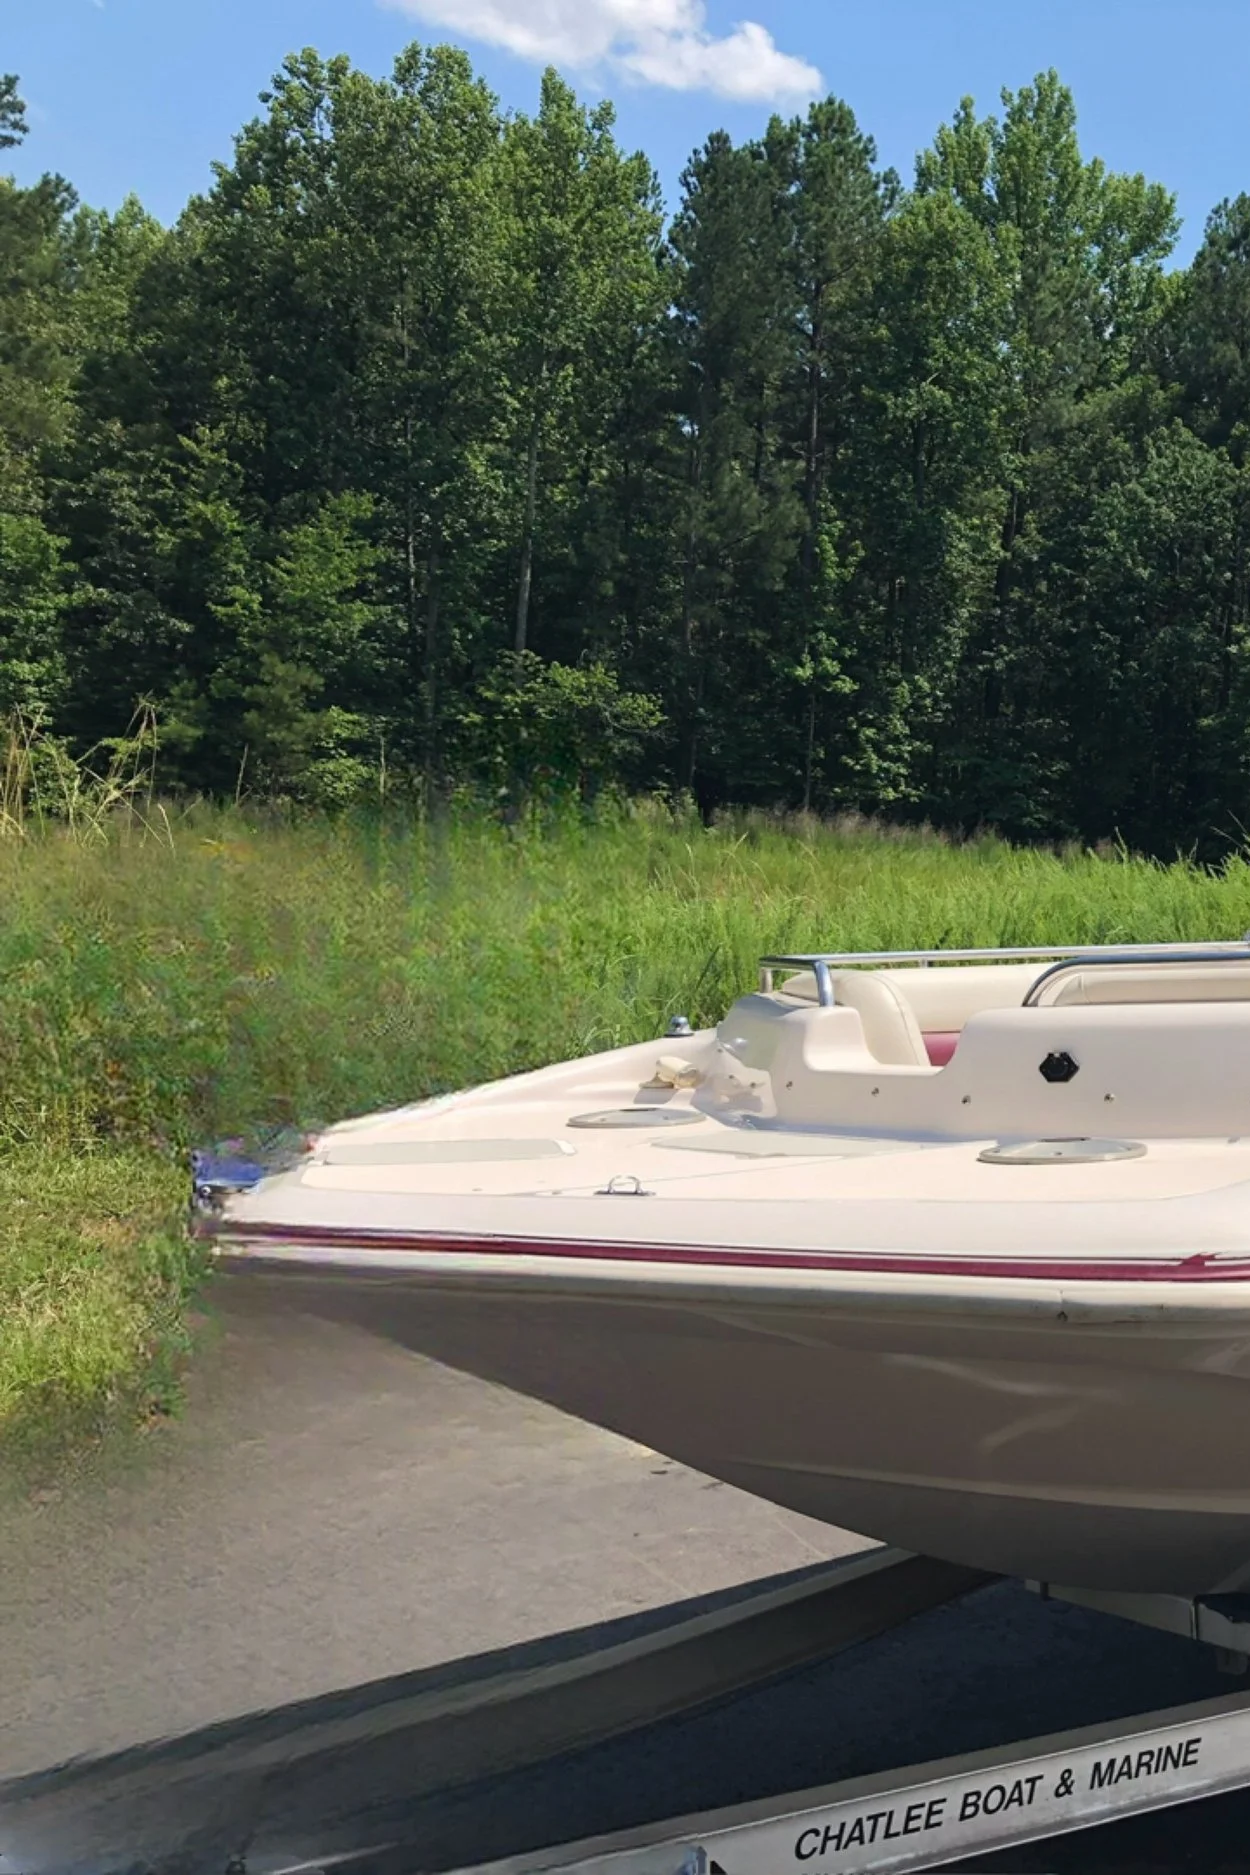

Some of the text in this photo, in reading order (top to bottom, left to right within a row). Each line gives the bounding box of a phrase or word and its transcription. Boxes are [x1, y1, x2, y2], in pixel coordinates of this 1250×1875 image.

[794, 1737, 1203, 1860] CHATLEE BOAT & MARINE
